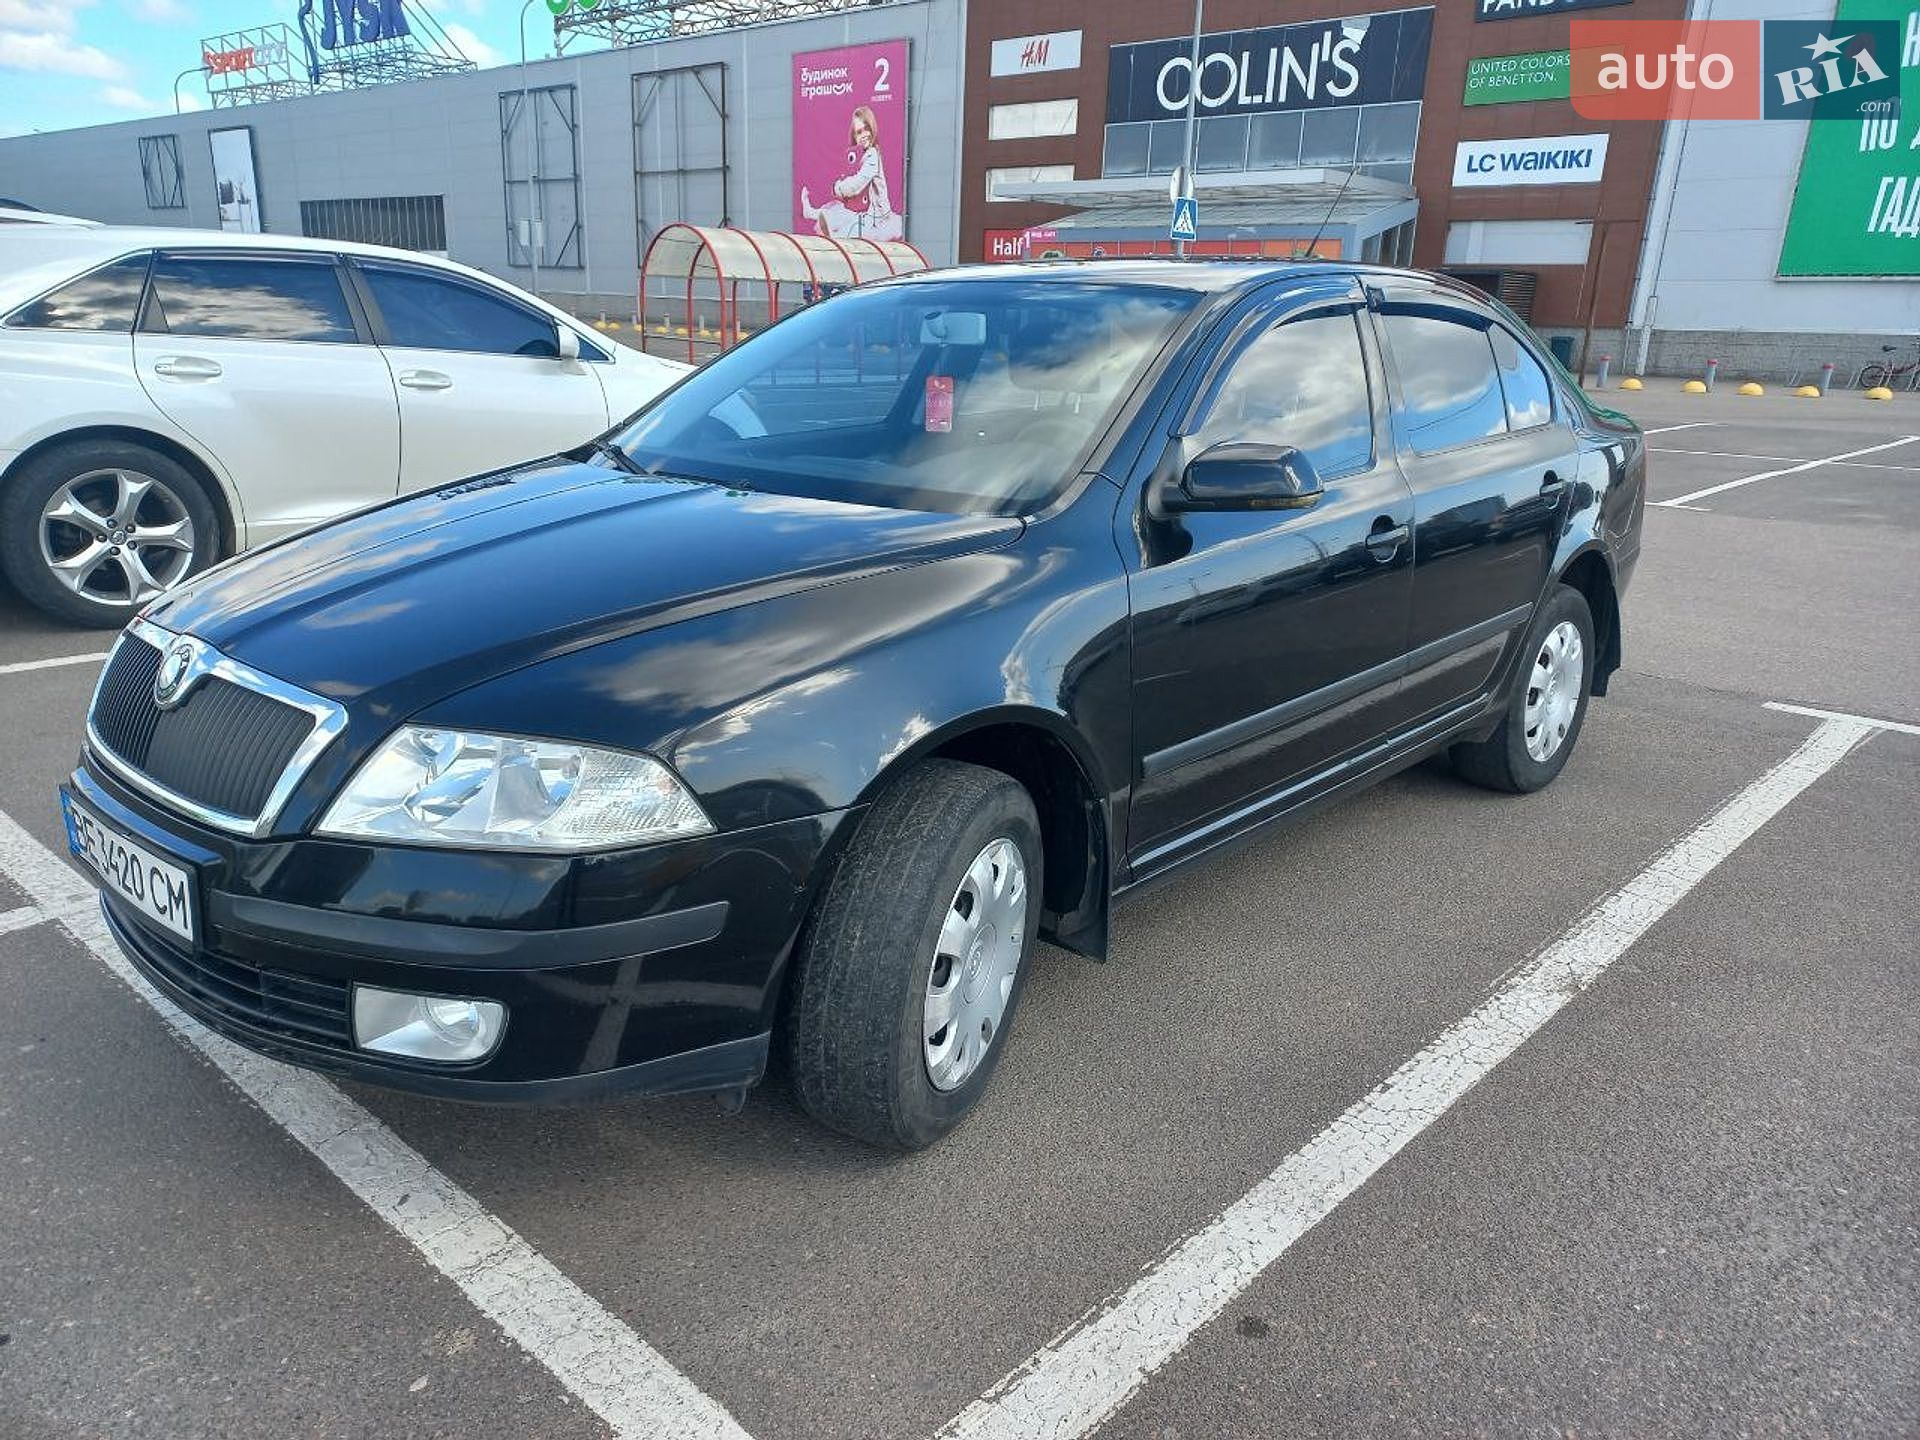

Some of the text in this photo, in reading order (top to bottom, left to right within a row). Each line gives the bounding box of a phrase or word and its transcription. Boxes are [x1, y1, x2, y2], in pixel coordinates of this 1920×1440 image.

[320, 0, 409, 49] JYSK
[874, 58, 889, 91] 2
[1156, 31, 1361, 111] COLIN'S
[1471, 54, 1571, 75] UNITED COLORS
[1470, 78, 1484, 89] OF
[1467, 154, 1496, 173] LC
[993, 237, 1025, 256] Half
[150, 866, 188, 930] CM
